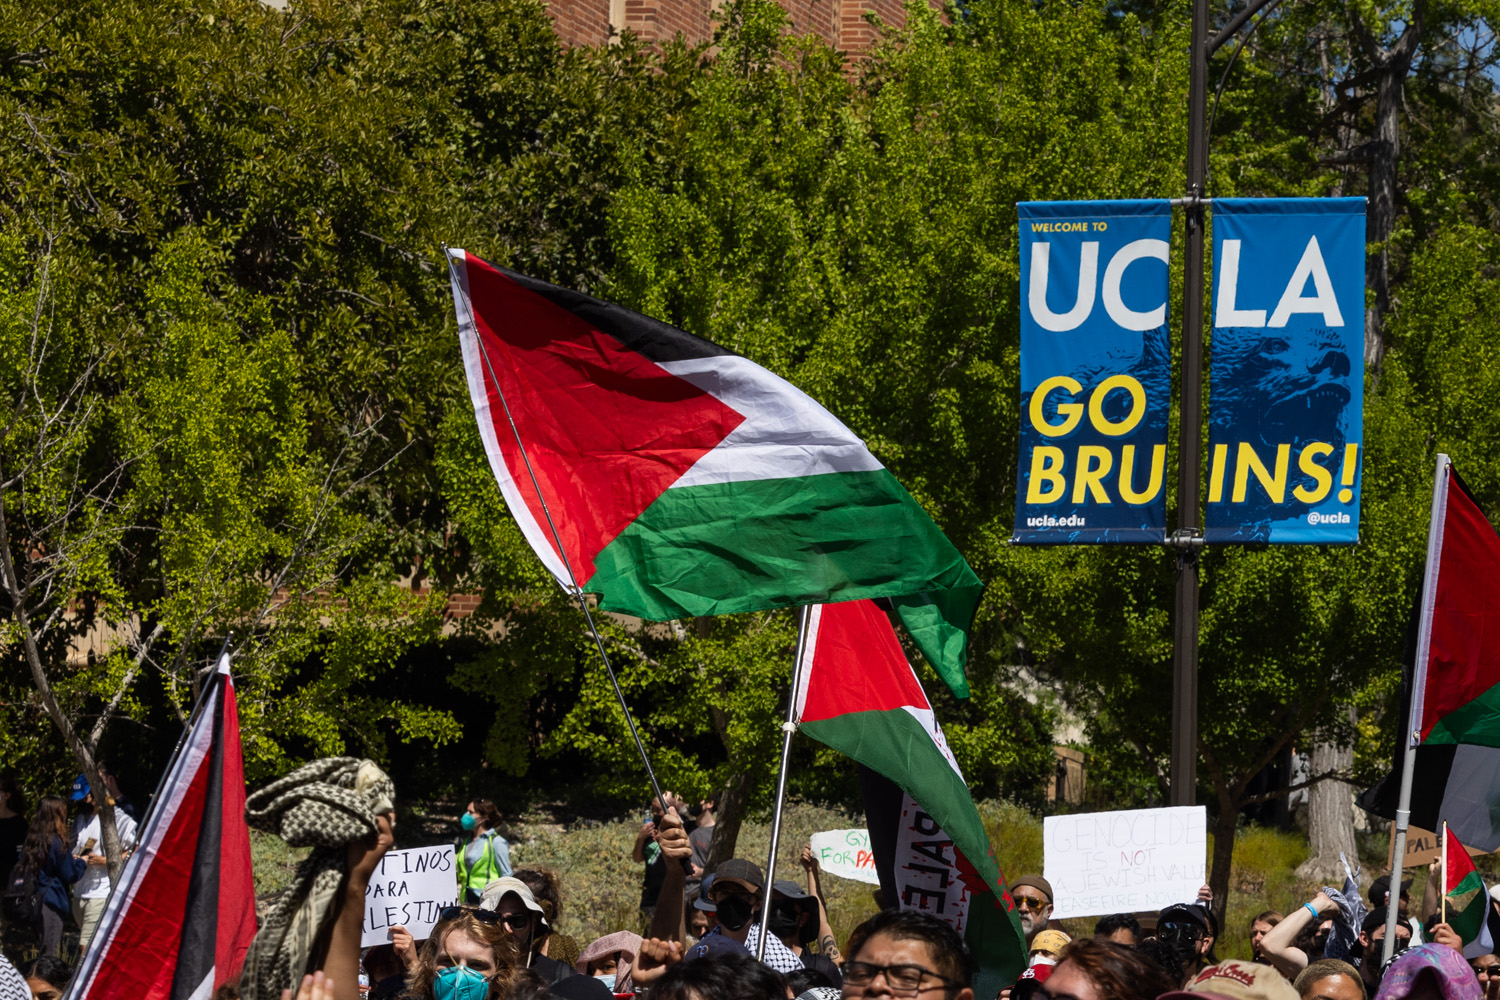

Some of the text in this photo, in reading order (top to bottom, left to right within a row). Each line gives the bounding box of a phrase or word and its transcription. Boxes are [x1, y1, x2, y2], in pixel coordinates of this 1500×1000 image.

[1031, 222, 1107, 233] WELCOME TO
[1029, 374, 1147, 437] GO
[1027, 513, 1085, 527] ucla.edu
[1307, 511, 1351, 525] @ucla
[1052, 812, 1206, 853] GENOCIDE
[821, 847, 856, 865] FOR
[1080, 847, 1157, 873] IS NOT
[1054, 877, 1069, 894] A
[1070, 866, 1157, 894] JEWISH
